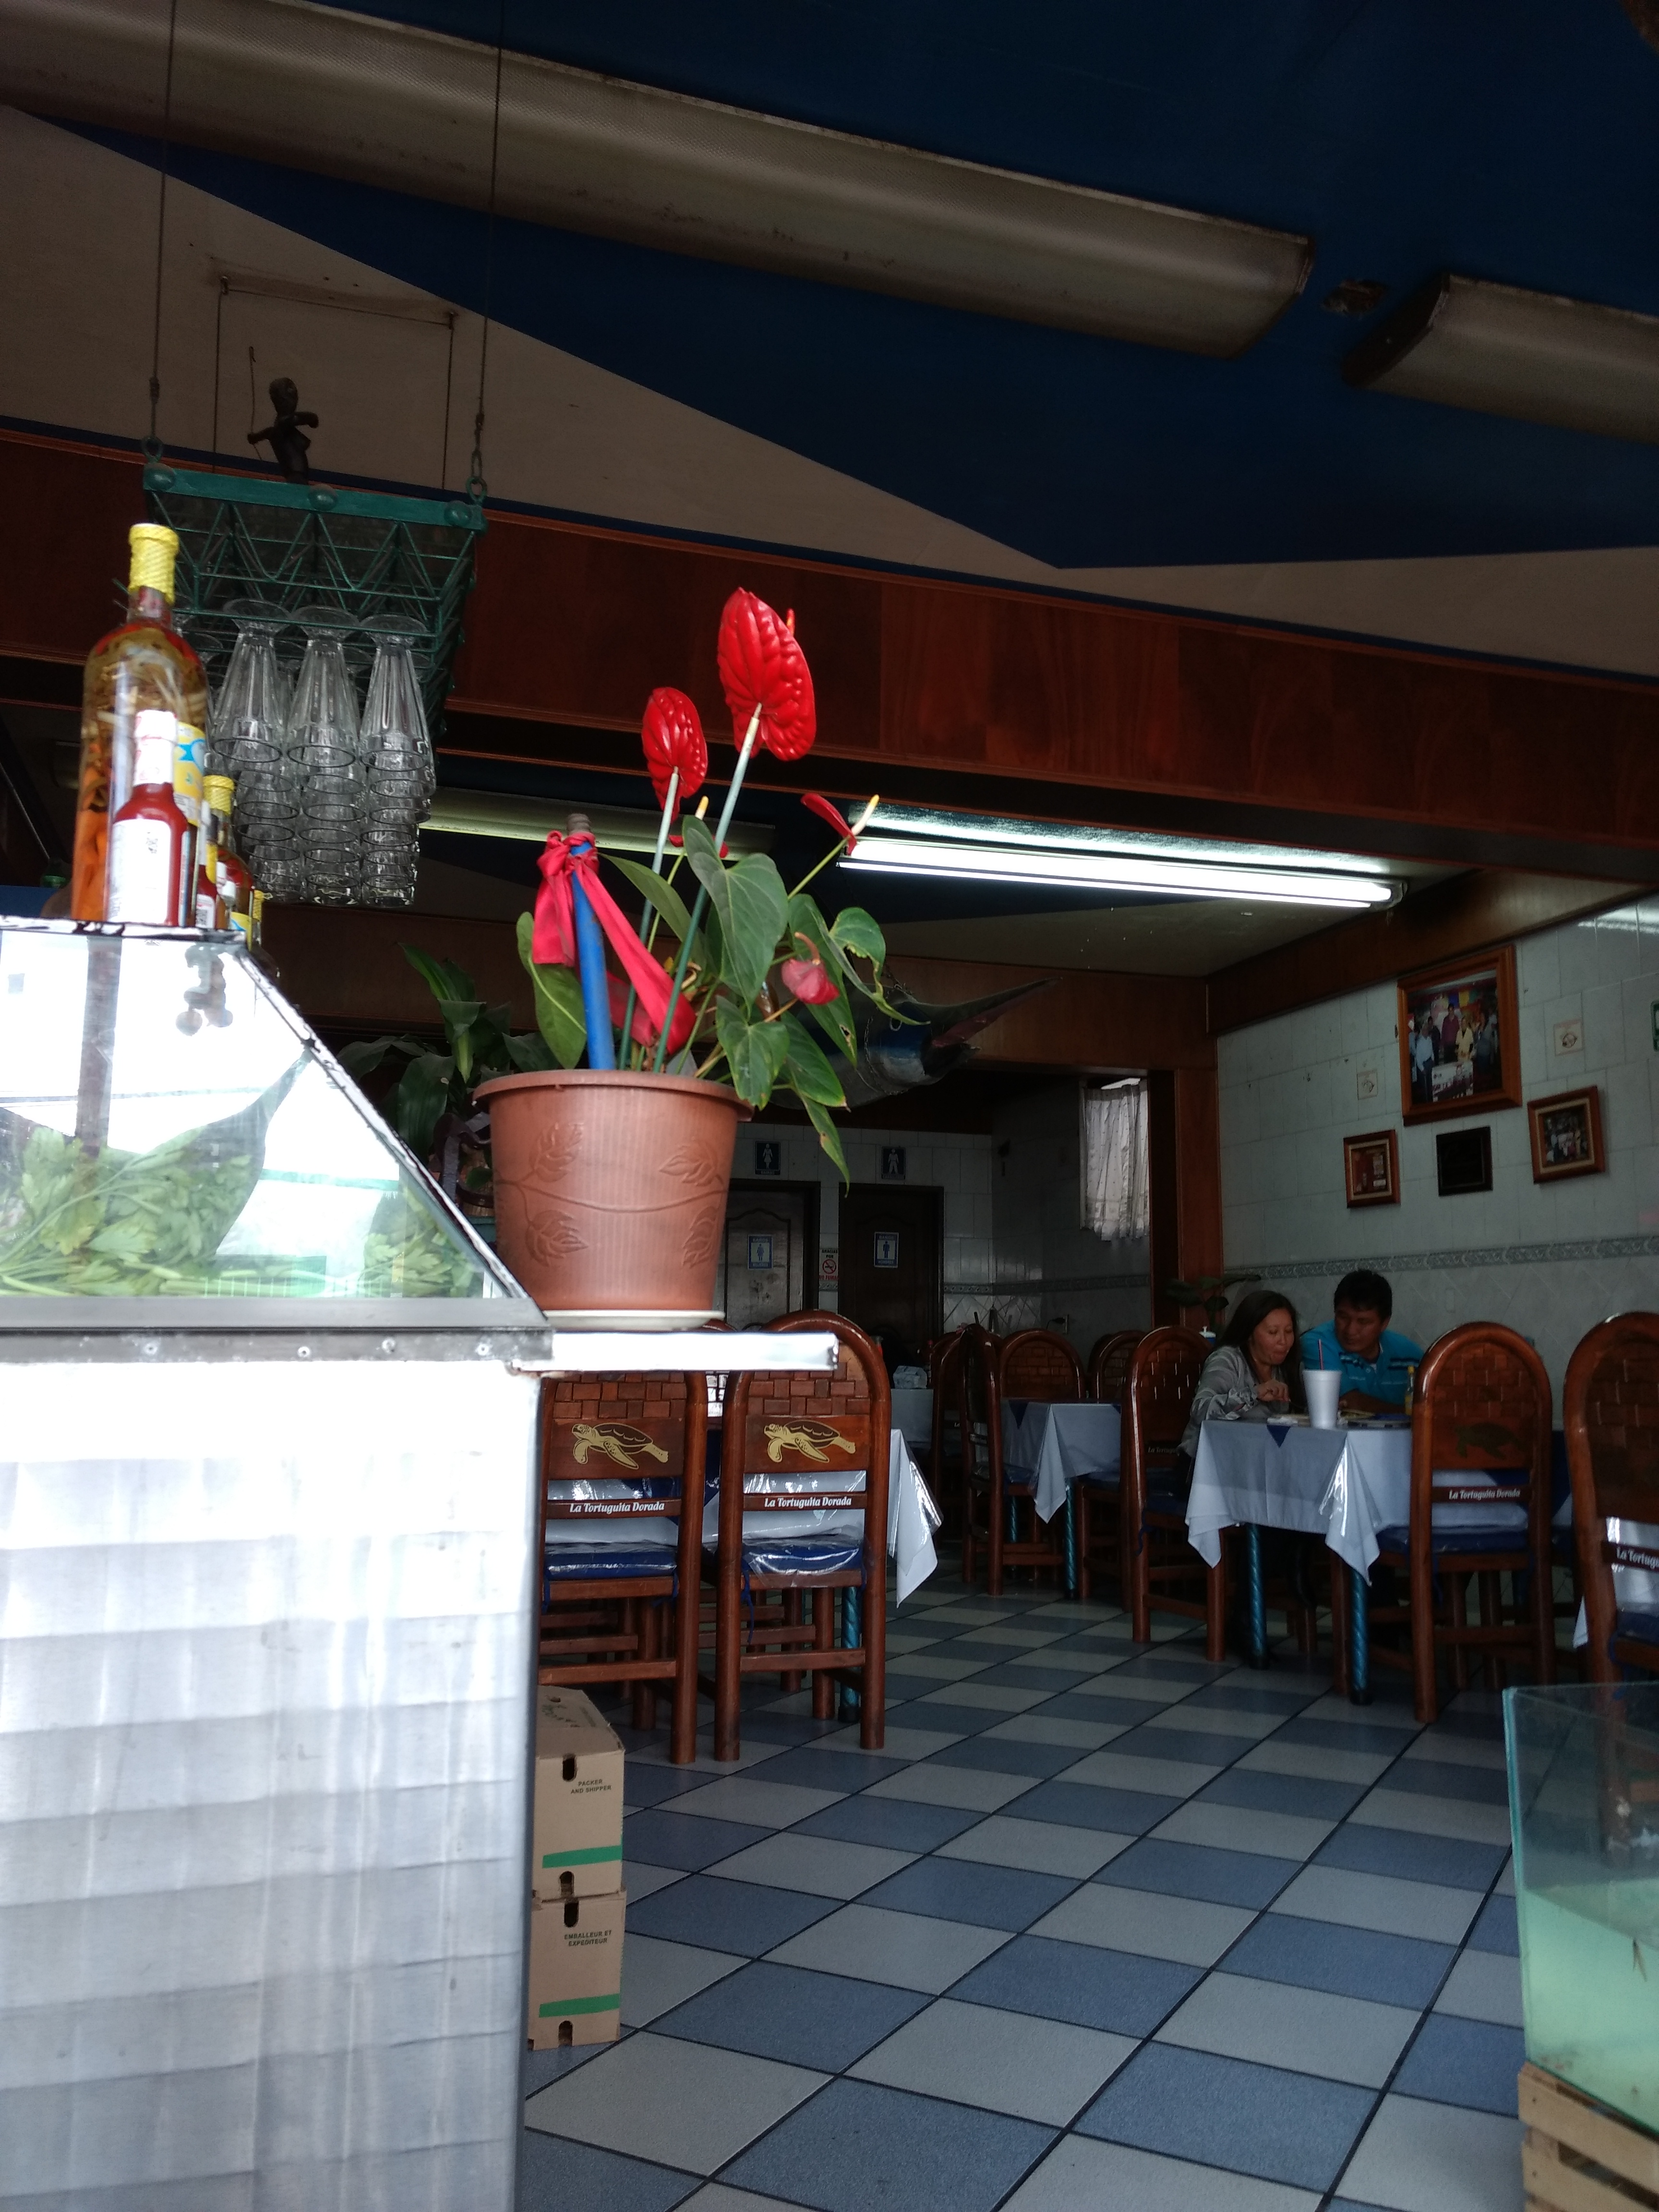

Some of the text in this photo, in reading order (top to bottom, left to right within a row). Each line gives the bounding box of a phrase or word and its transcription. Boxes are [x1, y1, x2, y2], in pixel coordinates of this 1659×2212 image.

[1449, 1488, 1520, 1501] La Tortuguita Dorada
[570, 1501, 665, 1514] La Tortuguita Dorada
[764, 1496, 852, 1509] La Tortuguita Dorada
[1616, 1547, 1627, 1560] La
[564, 1931, 602, 1939] EMBALLEUR
